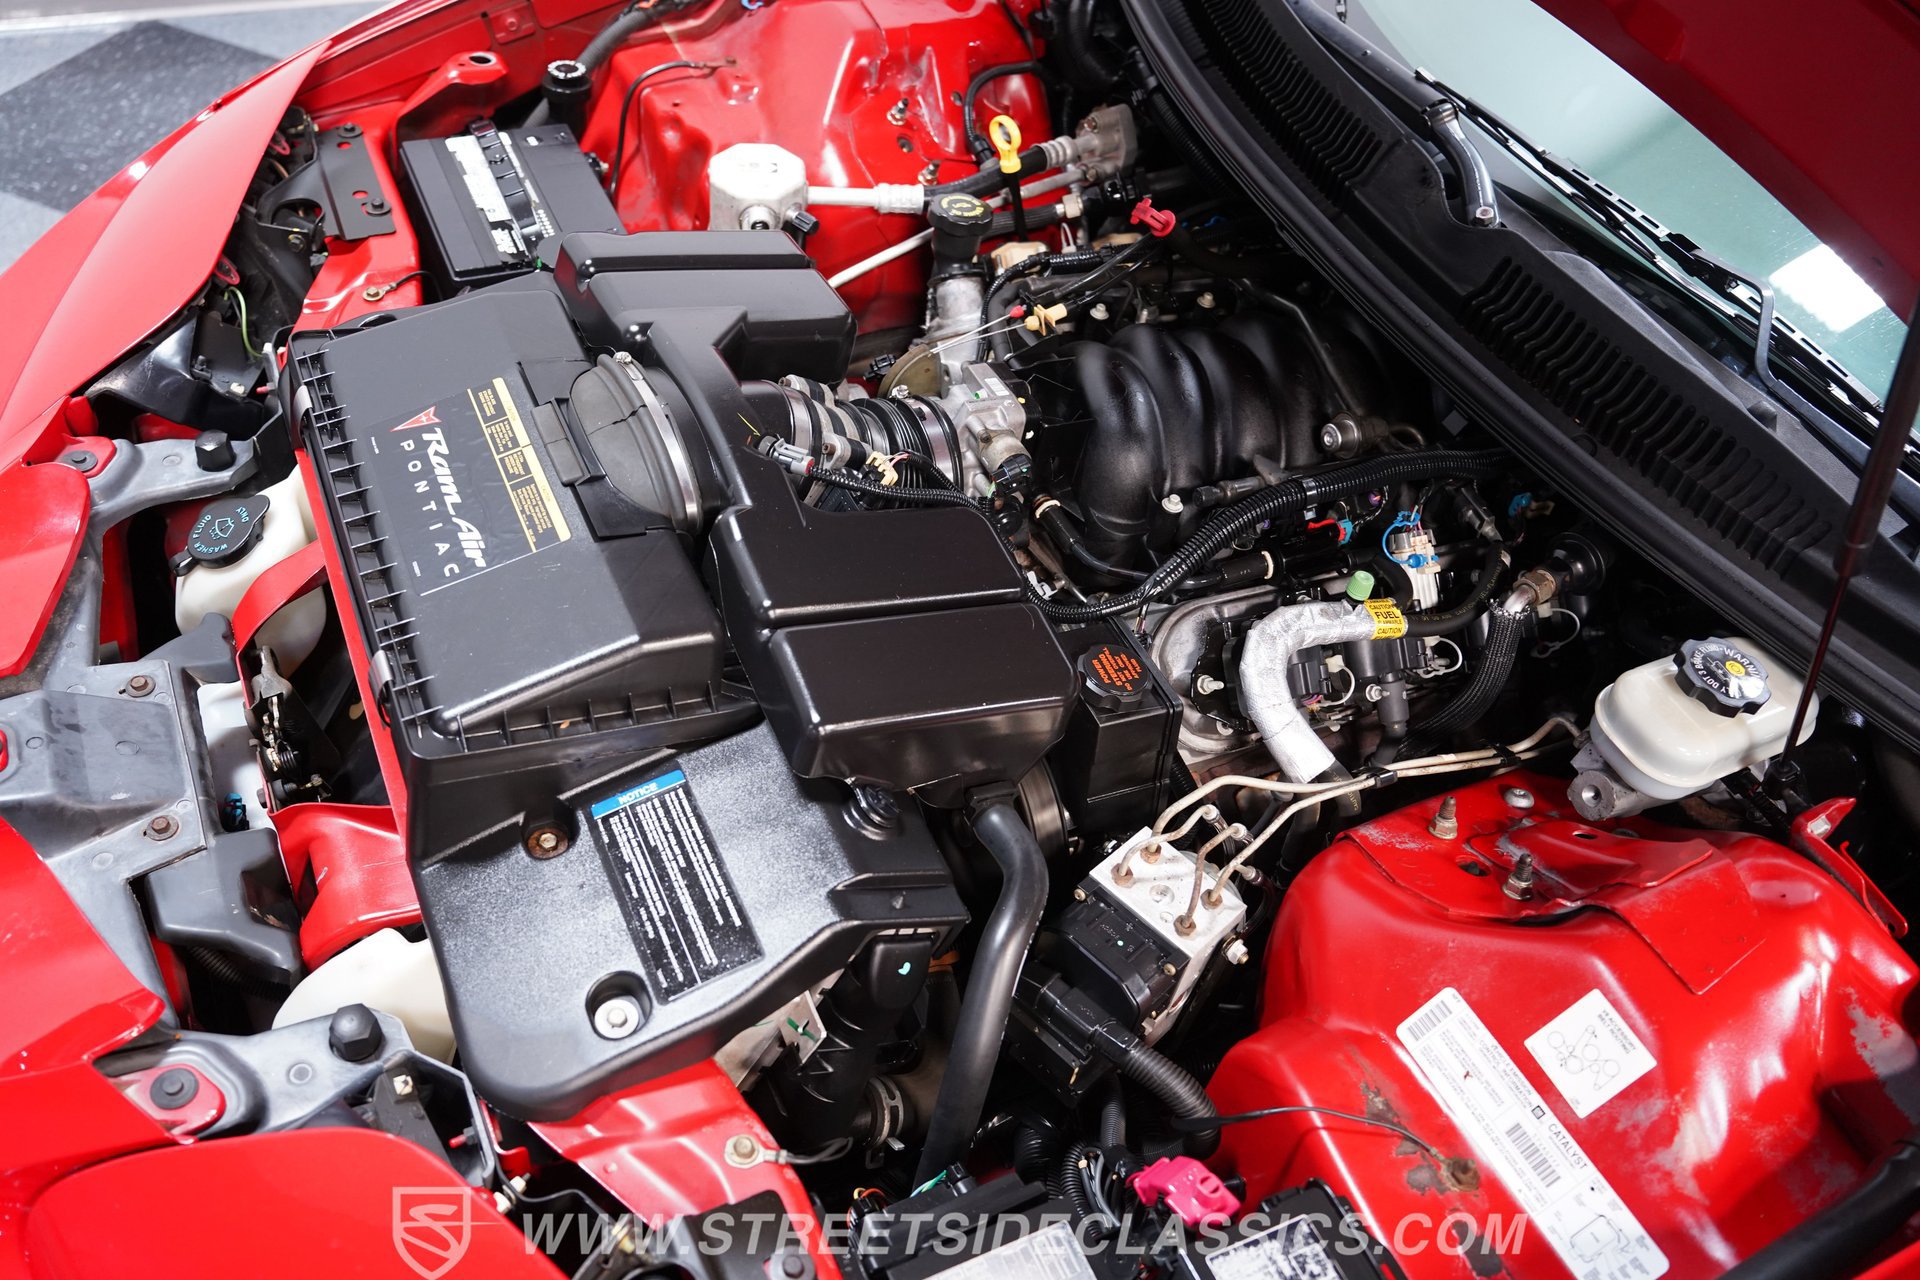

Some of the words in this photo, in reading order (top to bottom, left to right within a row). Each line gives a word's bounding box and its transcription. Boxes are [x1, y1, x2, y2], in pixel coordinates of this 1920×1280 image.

[236, 507, 249, 523] ONLY
[400, 439, 460, 577] PONTIAC
[193, 515, 212, 538] FLUID
[194, 542, 227, 554] WASHER
[1375, 611, 1399, 619] FUEL
[1098, 653, 1123, 686] STEERING
[1114, 656, 1125, 667] ONLY
[1120, 654, 1139, 678] APPROVED
[1130, 658, 1142, 672] FLUID
[1693, 649, 1703, 669] BRAKE
[1092, 659, 1111, 683] POWER
[1117, 671, 1127, 681] NOT
[1123, 670, 1132, 680] USE
[1703, 675, 1719, 689] DOT
[618, 782, 658, 804] NOTICE
[1596, 1013, 1611, 1028] BELT
[1608, 1028, 1631, 1054] ROUTING
[1478, 1039, 1501, 1066] CONTROL
[1501, 1067, 1533, 1108] INFORMATION
[1490, 1043, 1511, 1068] VEHICLE
[1509, 1067, 1533, 1096] EMISSION
[1547, 1122, 1588, 1171] CATALYST
